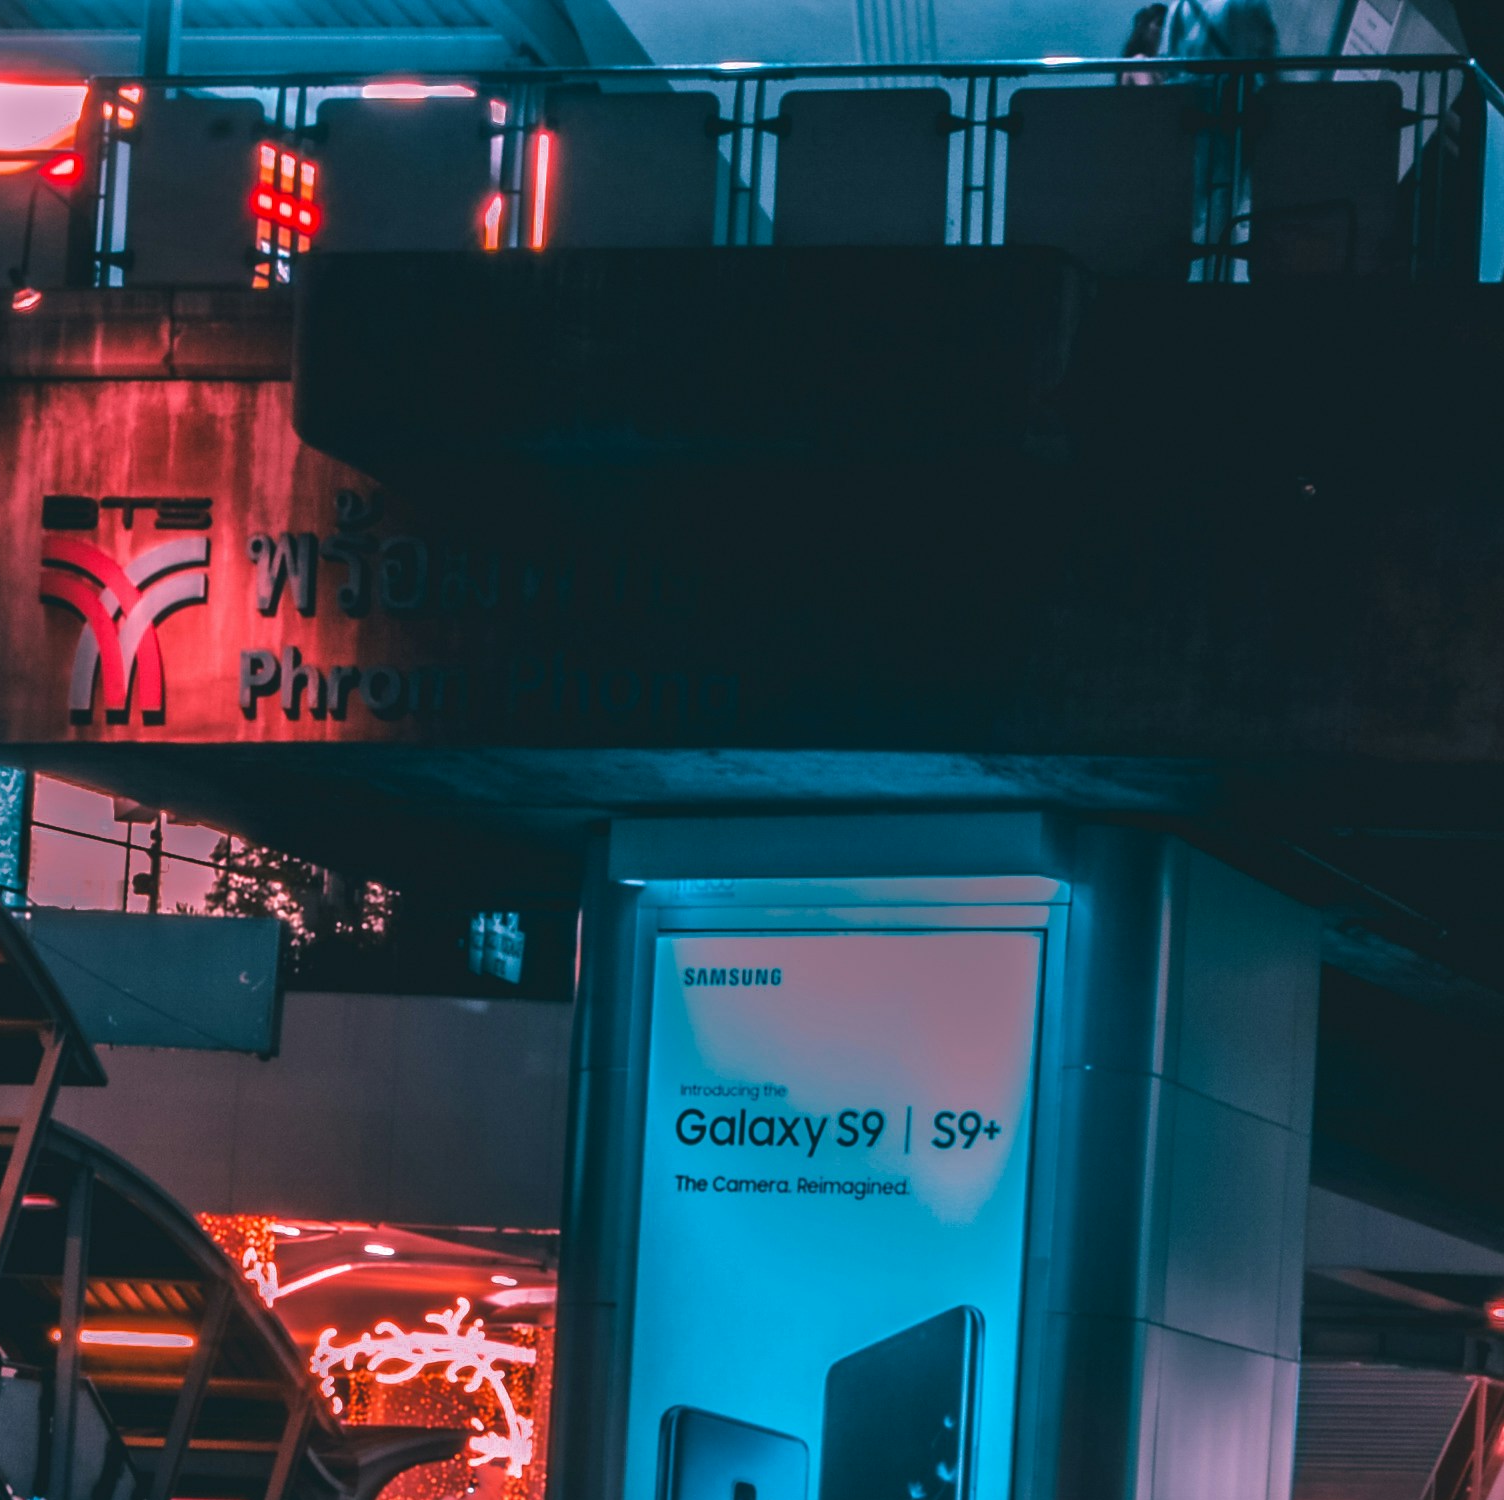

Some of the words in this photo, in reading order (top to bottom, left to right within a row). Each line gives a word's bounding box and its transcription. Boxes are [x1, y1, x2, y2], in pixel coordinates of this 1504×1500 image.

[41, 495, 213, 531] BTS
[239, 646, 469, 719] Phrom
[683, 967, 783, 987] SAMSUNG
[680, 1083, 760, 1101] Introducing
[764, 1083, 788, 1098] the
[675, 1108, 828, 1158] Galaxy
[836, 1109, 885, 1147] S9
[931, 1110, 1001, 1150] S9+
[674, 1174, 708, 1193] The
[712, 1175, 792, 1194] Camera.
[797, 1176, 911, 1201] Reimagined.
